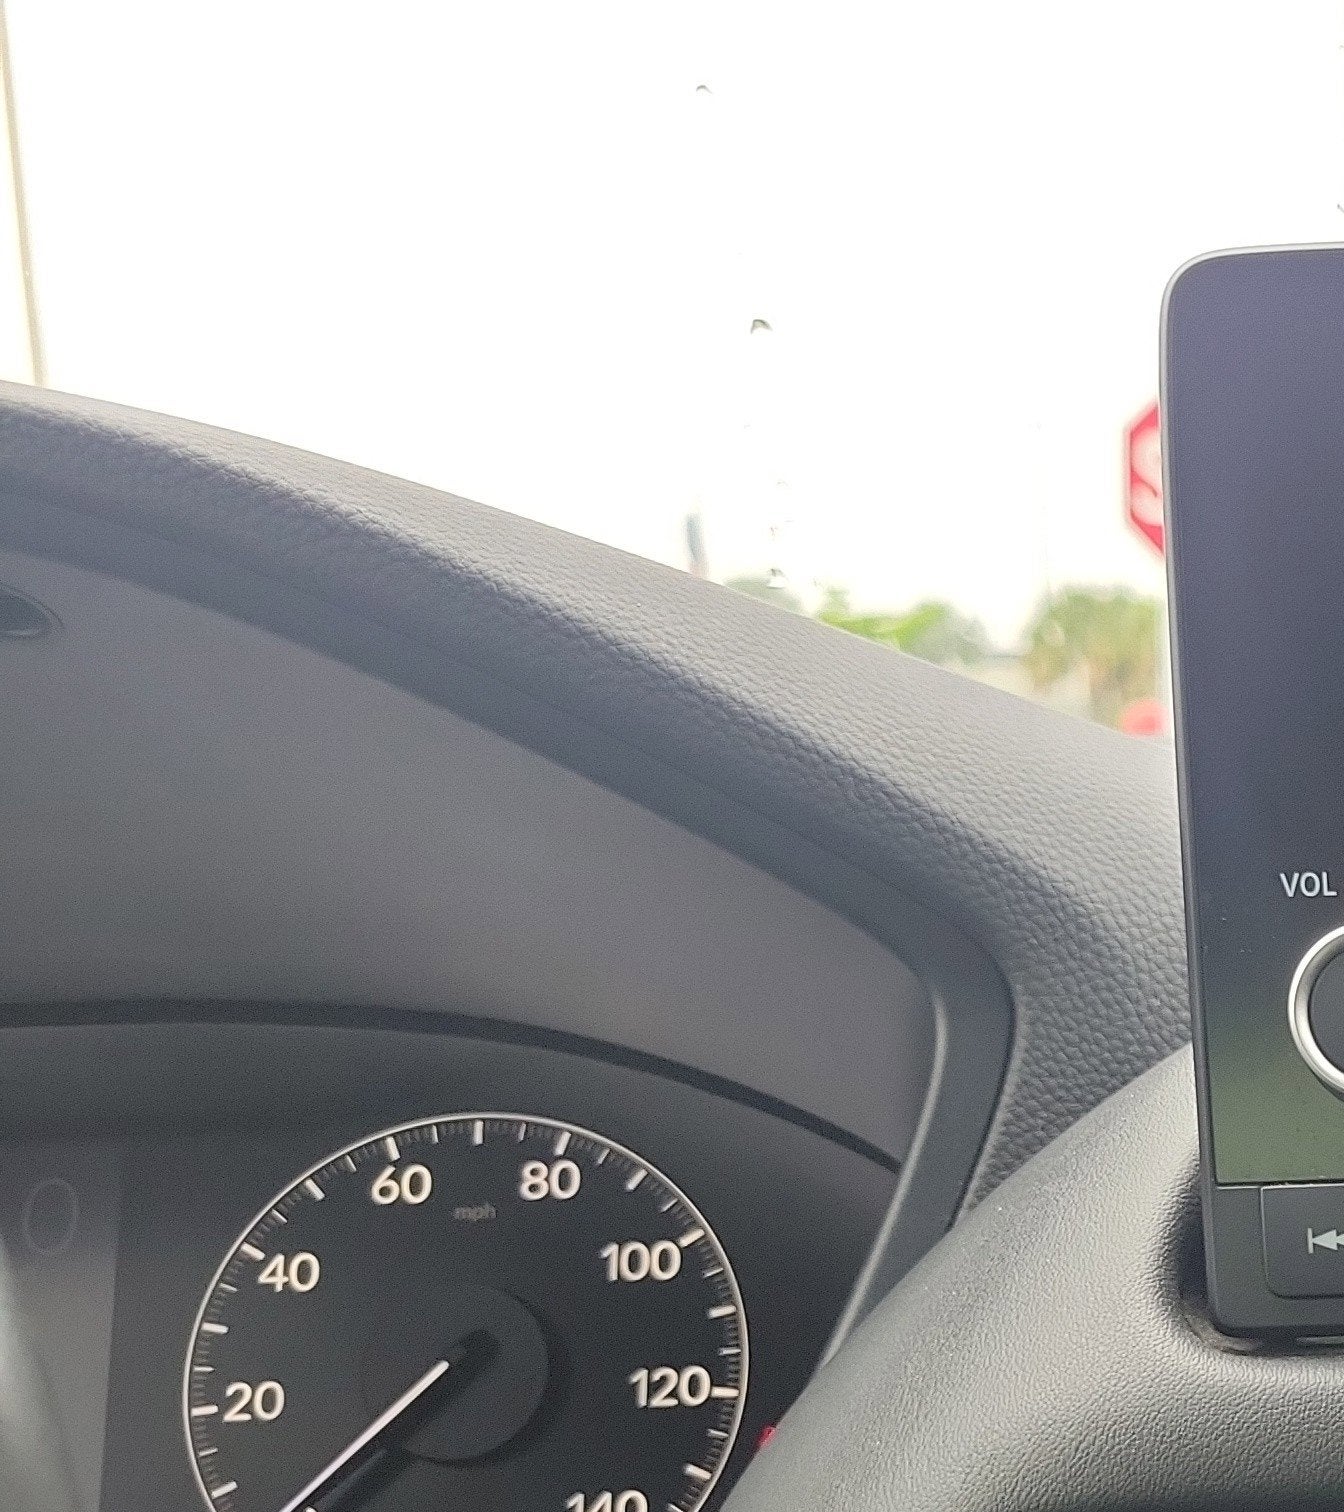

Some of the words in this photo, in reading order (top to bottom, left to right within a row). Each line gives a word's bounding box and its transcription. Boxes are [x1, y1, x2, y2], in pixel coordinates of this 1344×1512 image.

[1279, 871, 1338, 898] VOL
[371, 1164, 432, 1205] 60
[519, 1159, 581, 1201] 80
[258, 1254, 320, 1293] 40
[601, 1241, 681, 1281] 100
[223, 1380, 285, 1422] 20
[630, 1365, 711, 1408] 120
